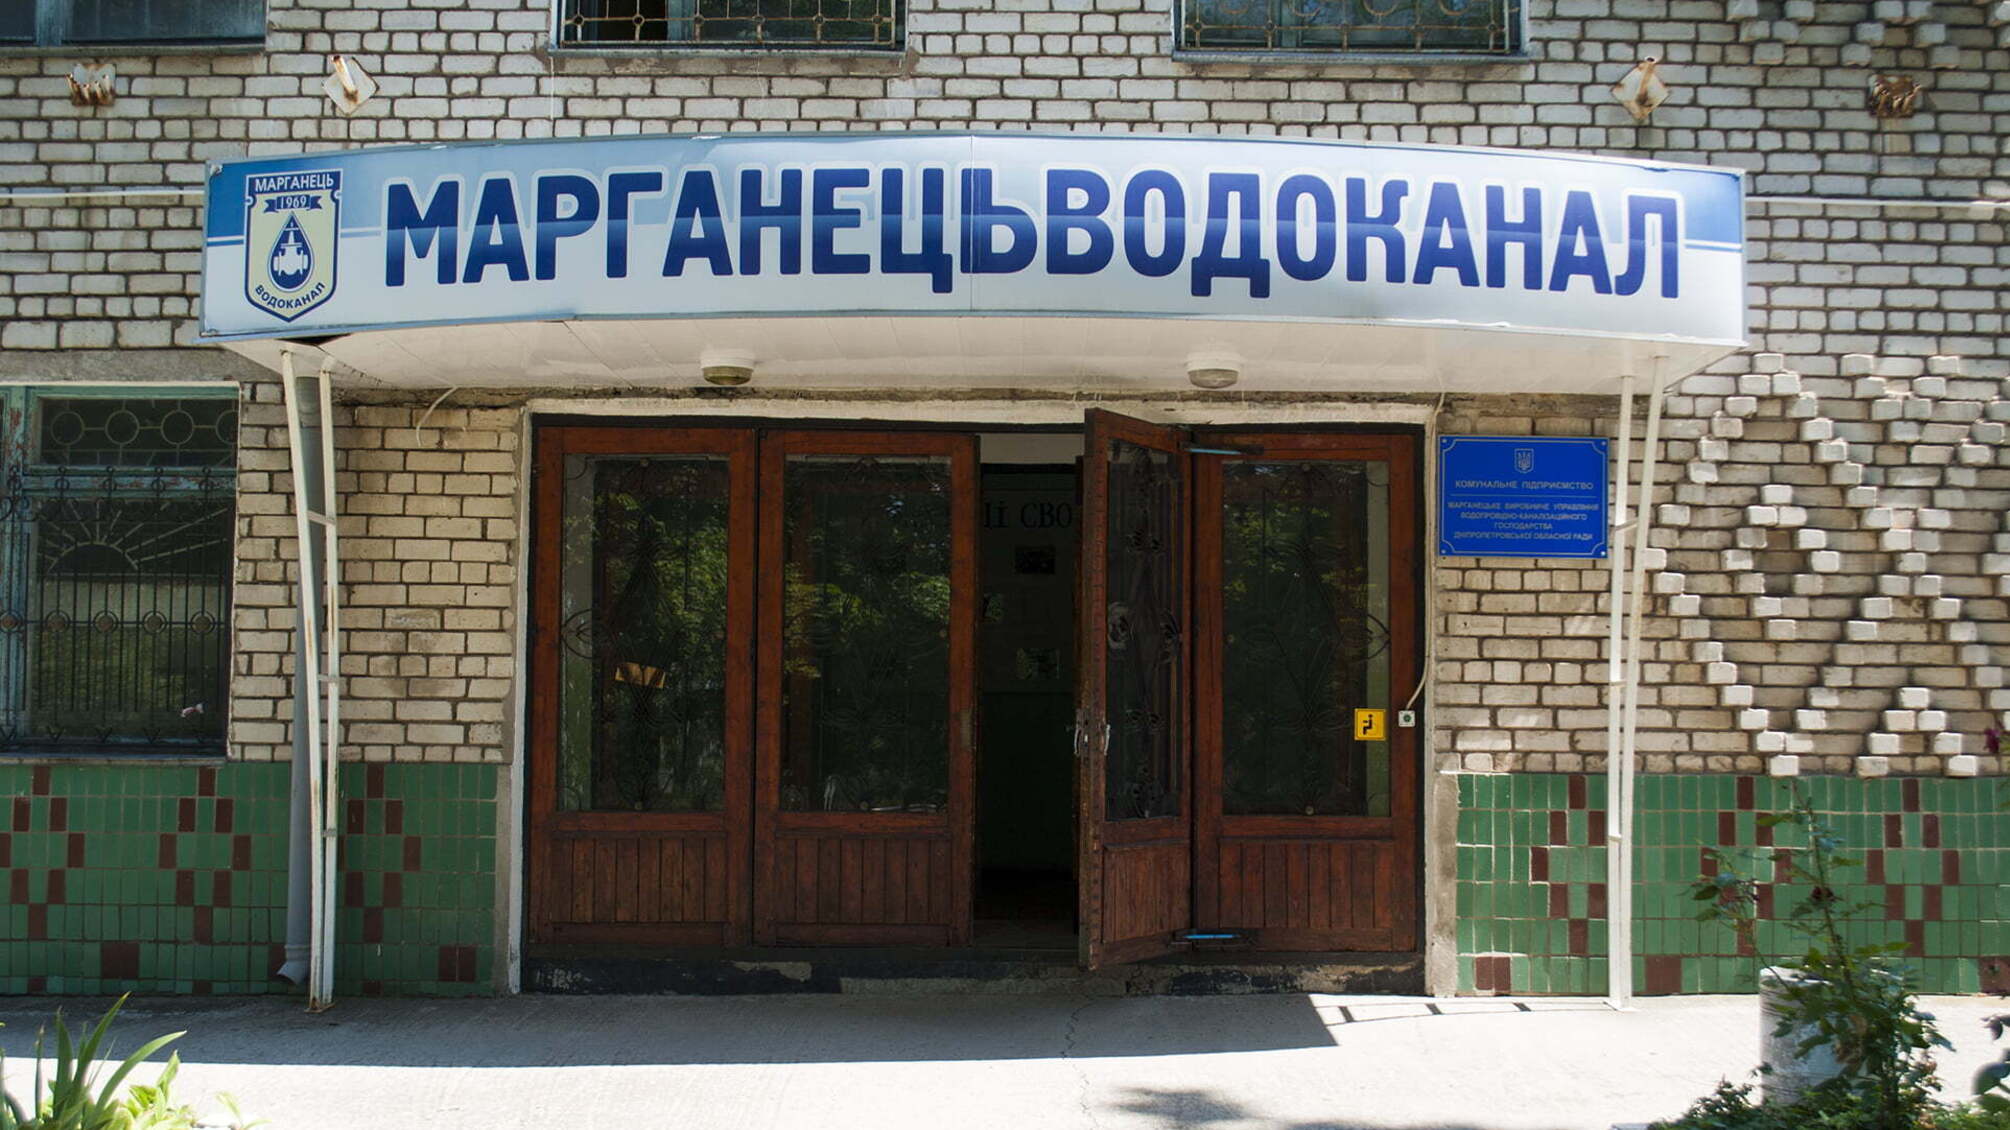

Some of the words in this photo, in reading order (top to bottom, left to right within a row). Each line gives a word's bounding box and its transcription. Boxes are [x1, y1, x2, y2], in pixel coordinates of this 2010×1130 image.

[255, 173, 334, 192] МАРГАНЕЦЬ
[279, 195, 308, 209] 1969
[386, 167, 1680, 299] МАРГАНЕЦЬВОДОКАНАЛ
[255, 282, 326, 309] ВОДОКАНАЛ
[1455, 480, 1517, 489] КОМУНАЛЬНЕ
[1521, 481, 1594, 490] ПІДПРИЄМСТВО
